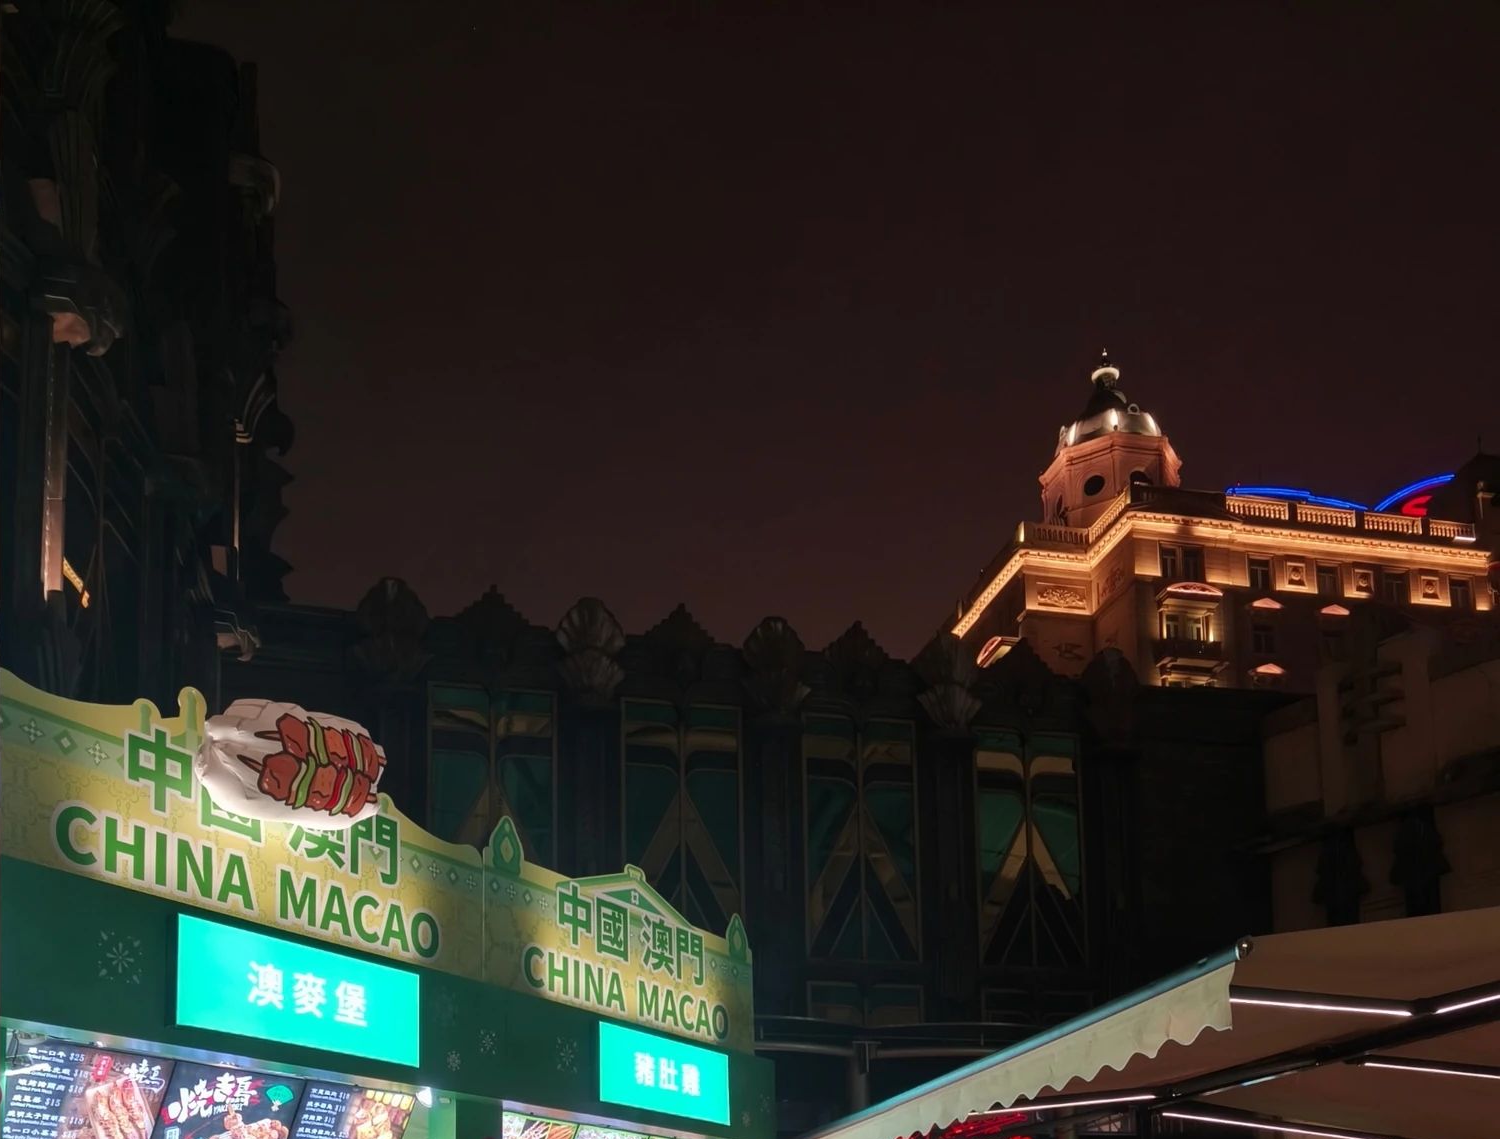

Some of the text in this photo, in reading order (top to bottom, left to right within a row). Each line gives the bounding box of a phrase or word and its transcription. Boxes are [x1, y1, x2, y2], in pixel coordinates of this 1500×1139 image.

[55, 805, 441, 959] CHINA MACAO
[247, 960, 368, 1027] 澳麥堡
[524, 946, 729, 1041] CHINA MACAO
[69, 1052, 85, 1062] $25
[44, 1098, 61, 1107] $15
[213, 1103, 244, 1116] YAKIORI
